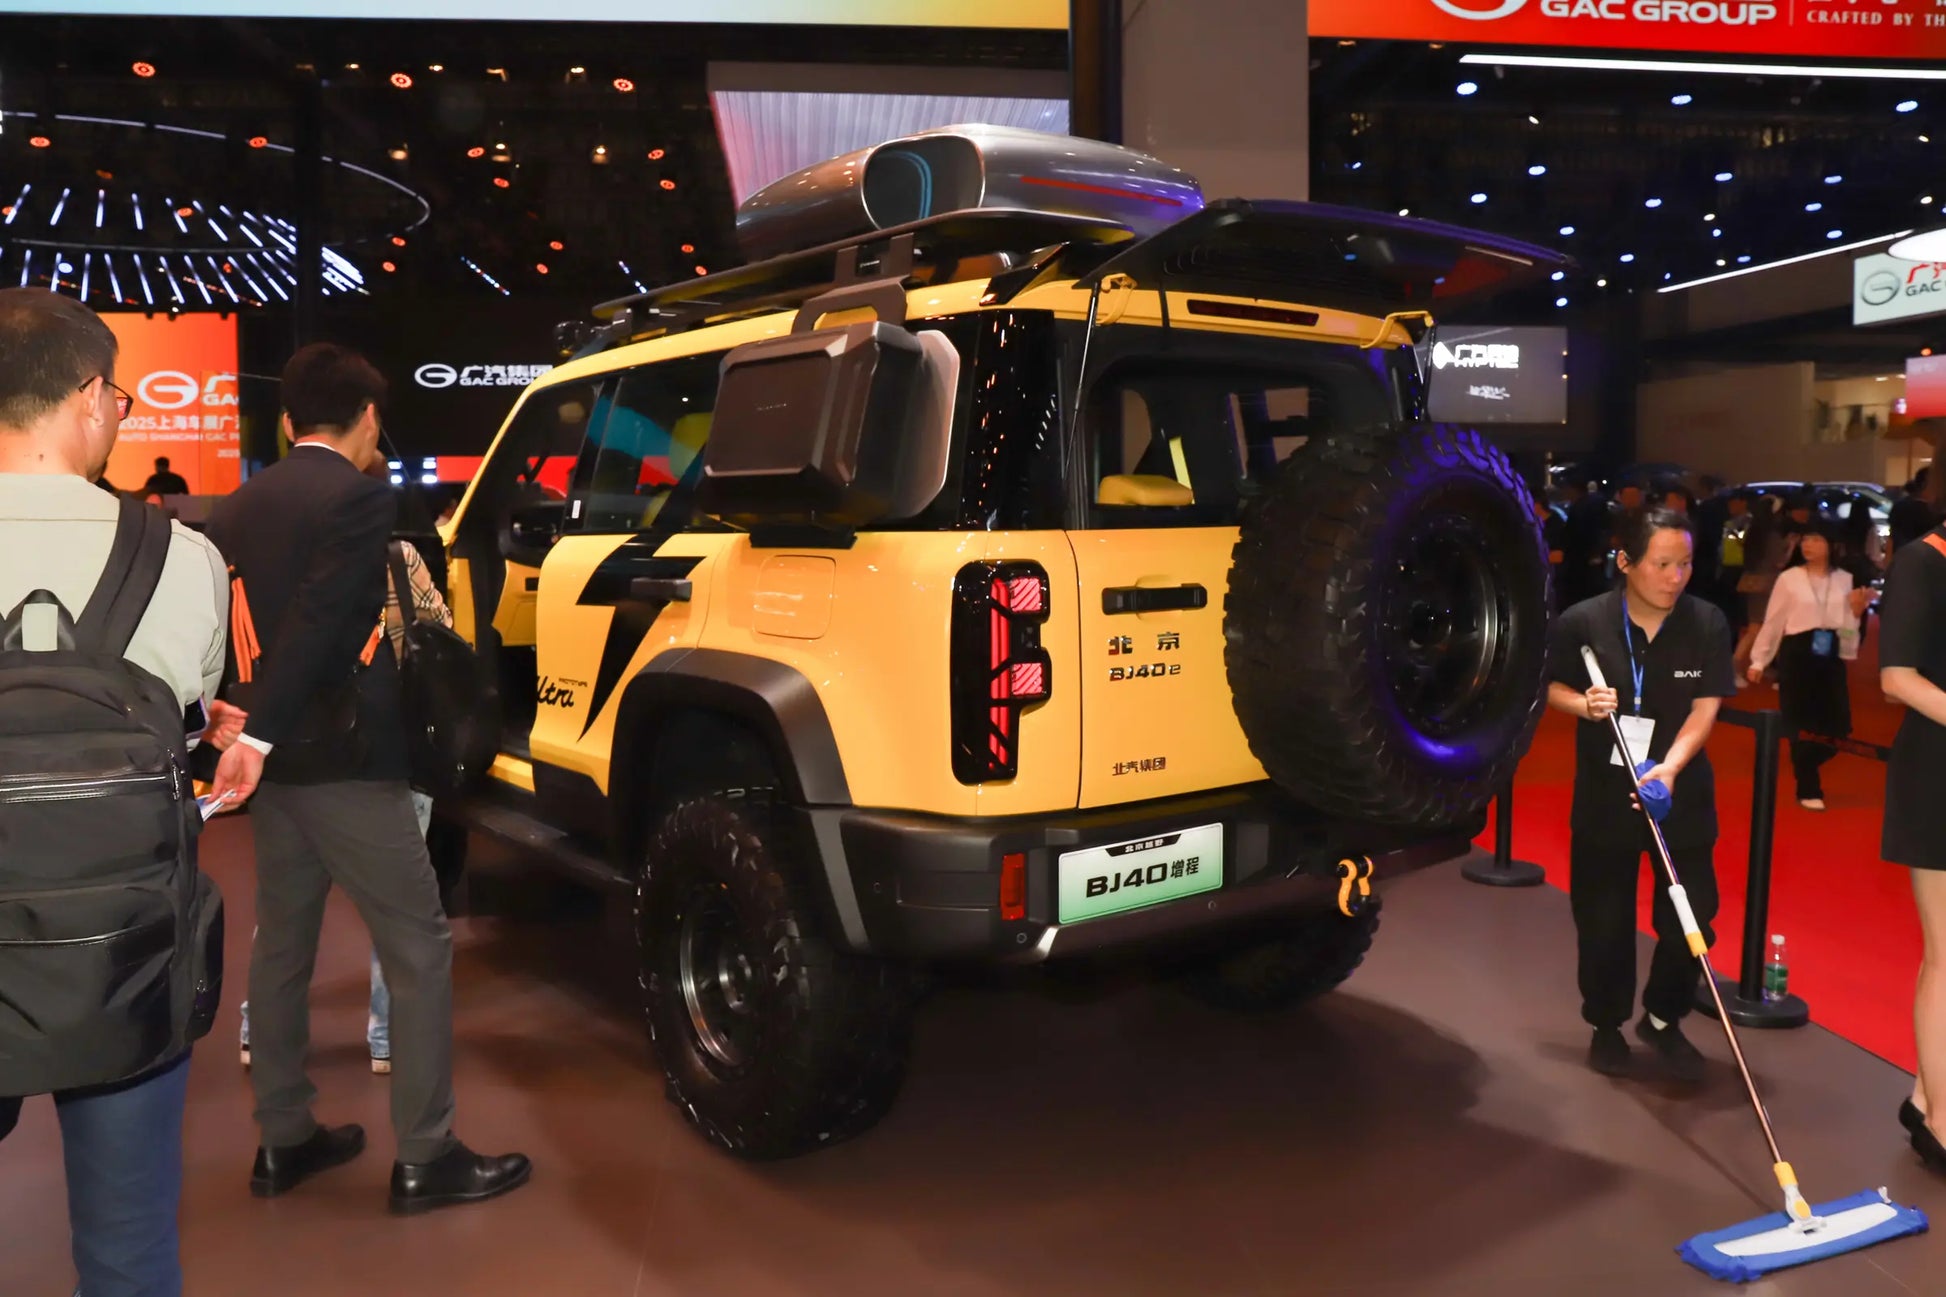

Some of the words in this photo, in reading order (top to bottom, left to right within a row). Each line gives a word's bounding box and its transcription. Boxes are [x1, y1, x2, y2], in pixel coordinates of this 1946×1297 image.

[1541, 0, 1626, 20] GAC
[1632, 1, 1777, 25] GROUP
[1806, 9, 1883, 25] CRAFTED
[1892, 12, 1915, 26] BY
[1905, 280, 1943, 297] GAC
[459, 377, 494, 386] GAC
[496, 377, 534, 386] GRO
[202, 393, 239, 406] GA
[1108, 632, 1180, 655] 北京
[537, 675, 575, 708] ltra
[1112, 756, 1166, 776] 北汽集团
[1124, 838, 1165, 853] 北京越野
